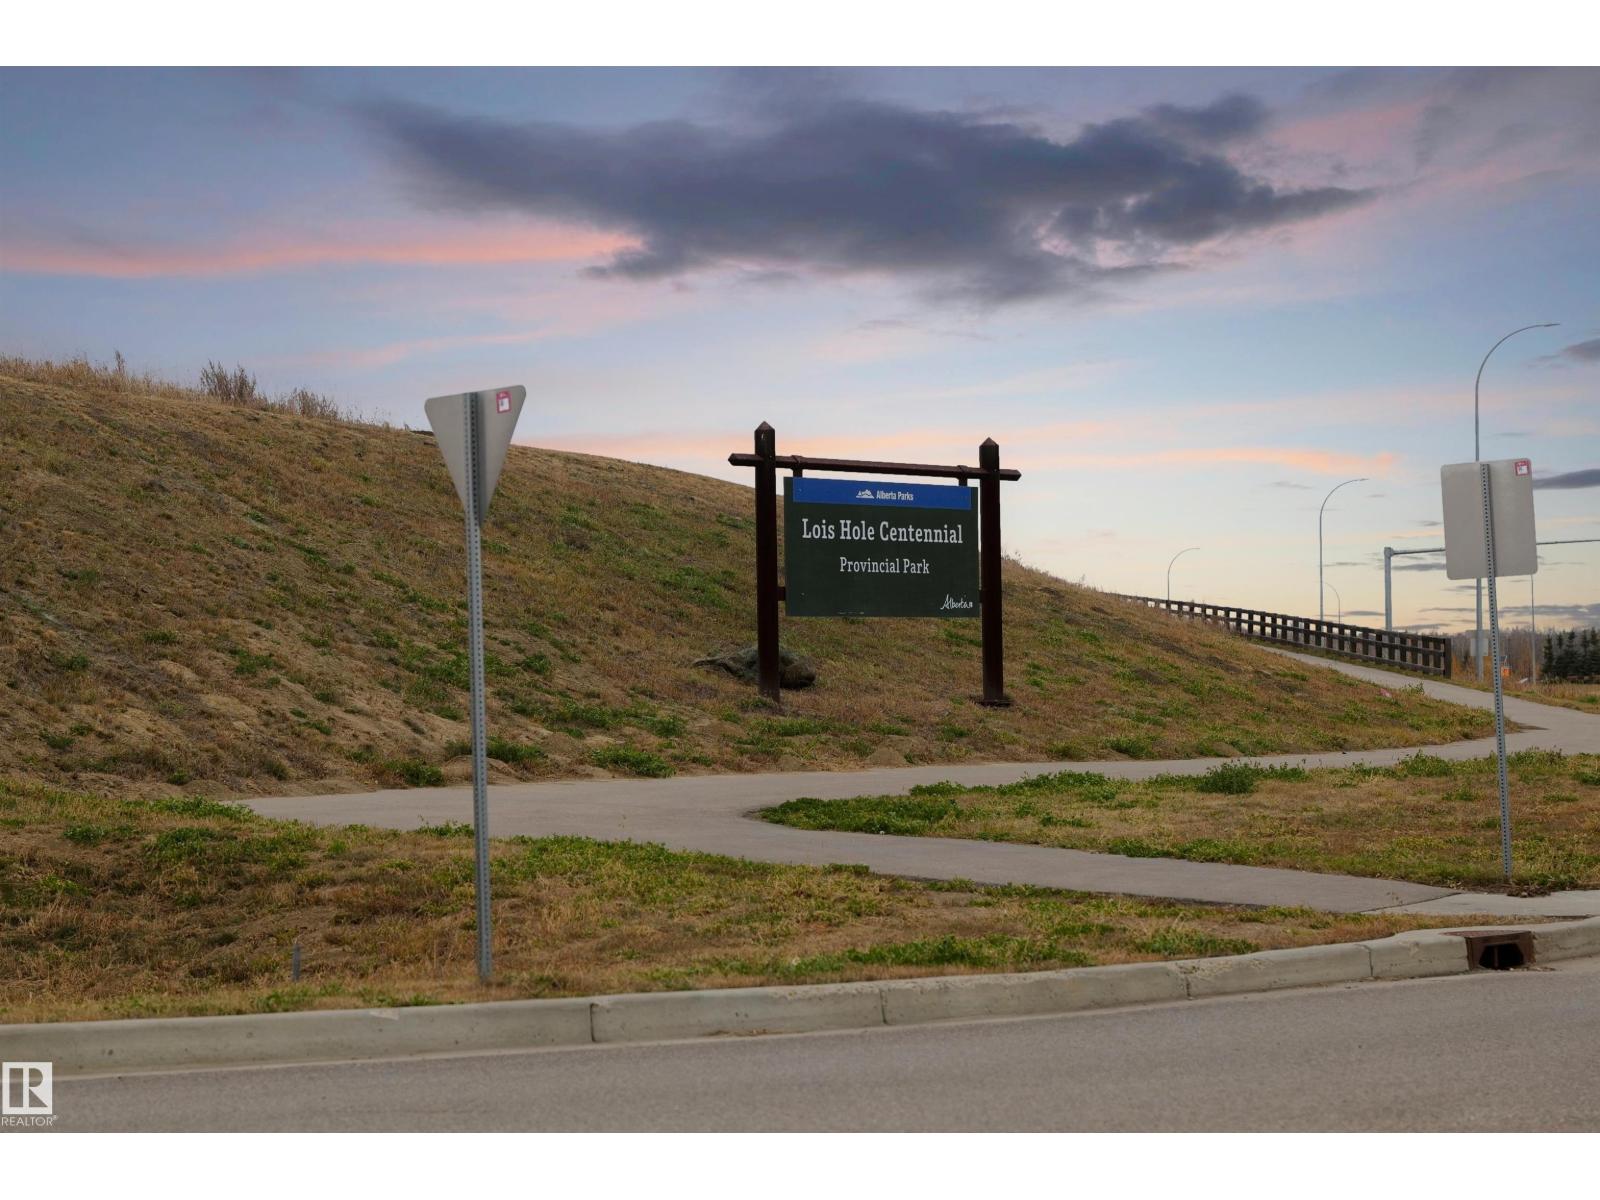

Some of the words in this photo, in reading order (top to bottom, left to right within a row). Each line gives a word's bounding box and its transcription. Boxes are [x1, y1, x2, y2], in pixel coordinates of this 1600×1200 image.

[876, 490, 897, 500] Alberta
[897, 491, 914, 501] Parks
[802, 518, 835, 540] Lois
[839, 519, 875, 541] Hole
[879, 520, 963, 544] Centennial
[840, 556, 900, 573] Provincial
[903, 558, 930, 574] Park
[940, 594, 970, 610] Alberta
